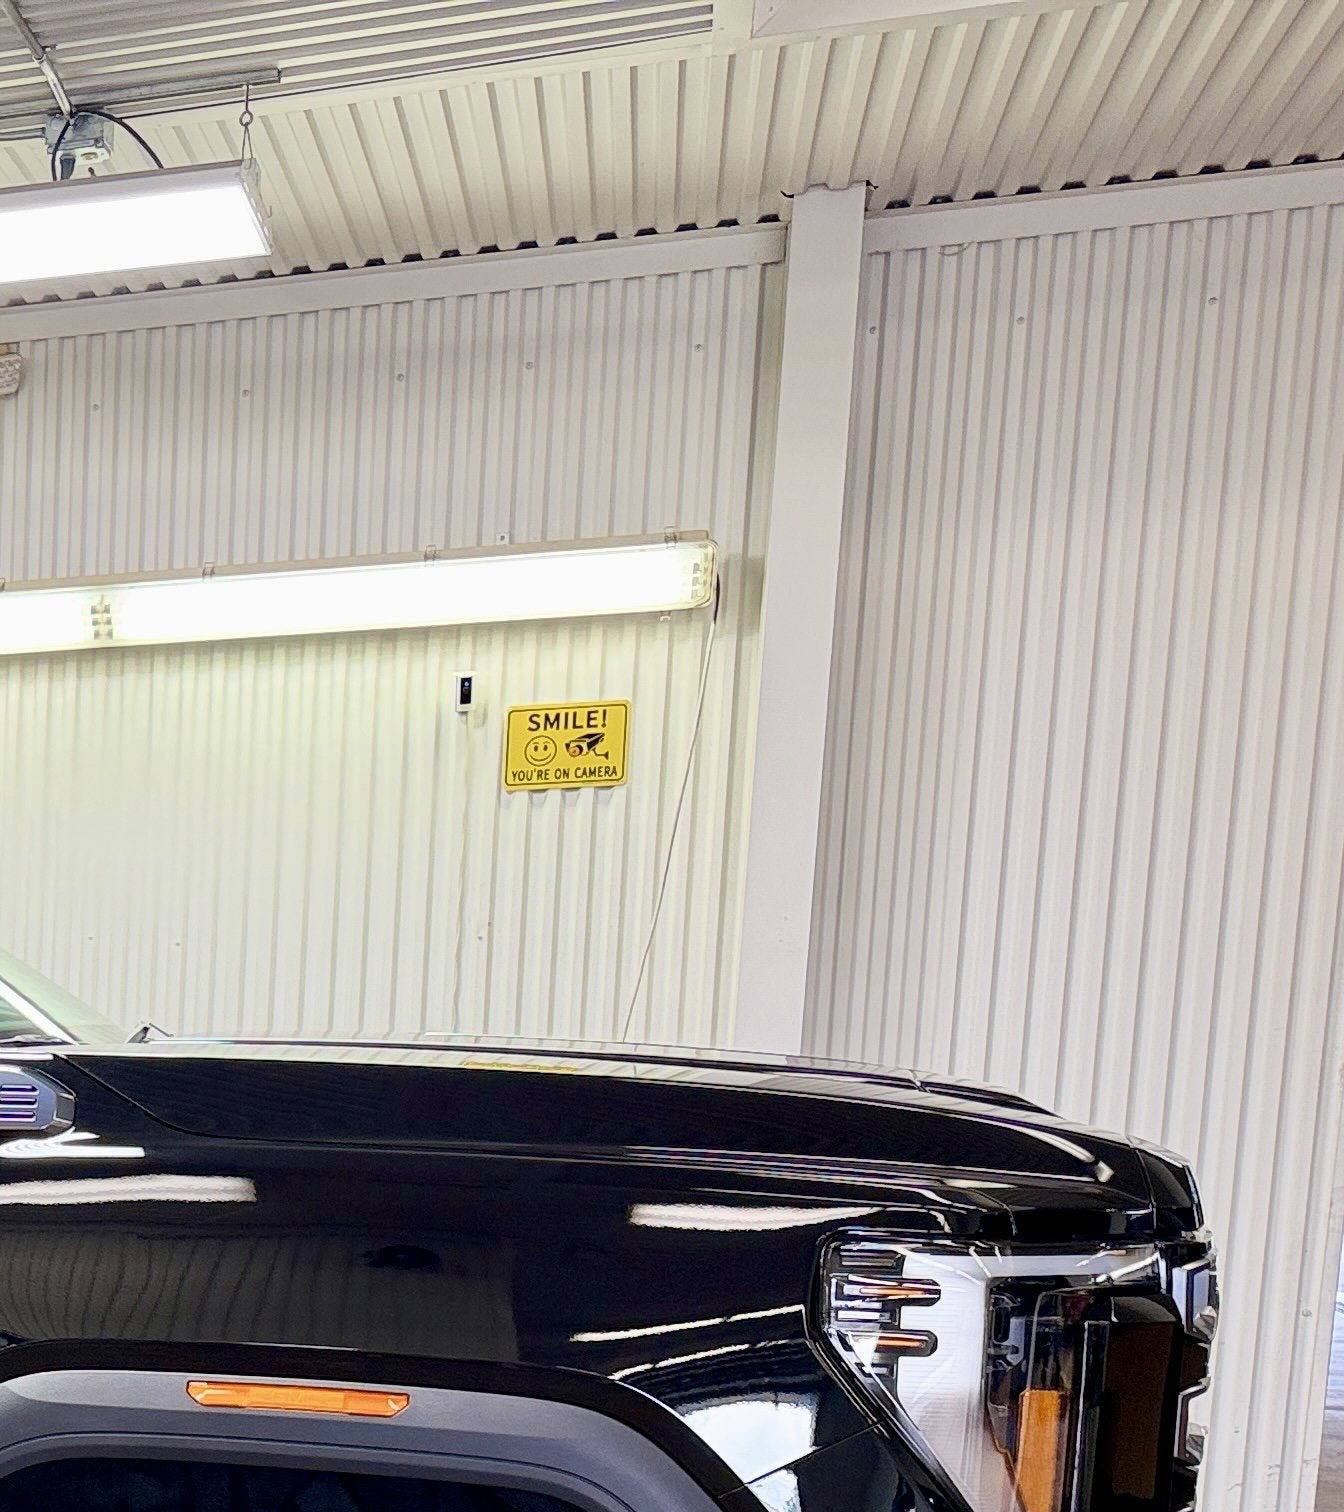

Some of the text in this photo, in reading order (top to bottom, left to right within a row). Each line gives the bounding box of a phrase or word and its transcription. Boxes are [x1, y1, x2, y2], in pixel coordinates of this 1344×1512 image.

[528, 709, 607, 732] SMILE!
[512, 766, 618, 782] YOU'RE ON CAMERA
